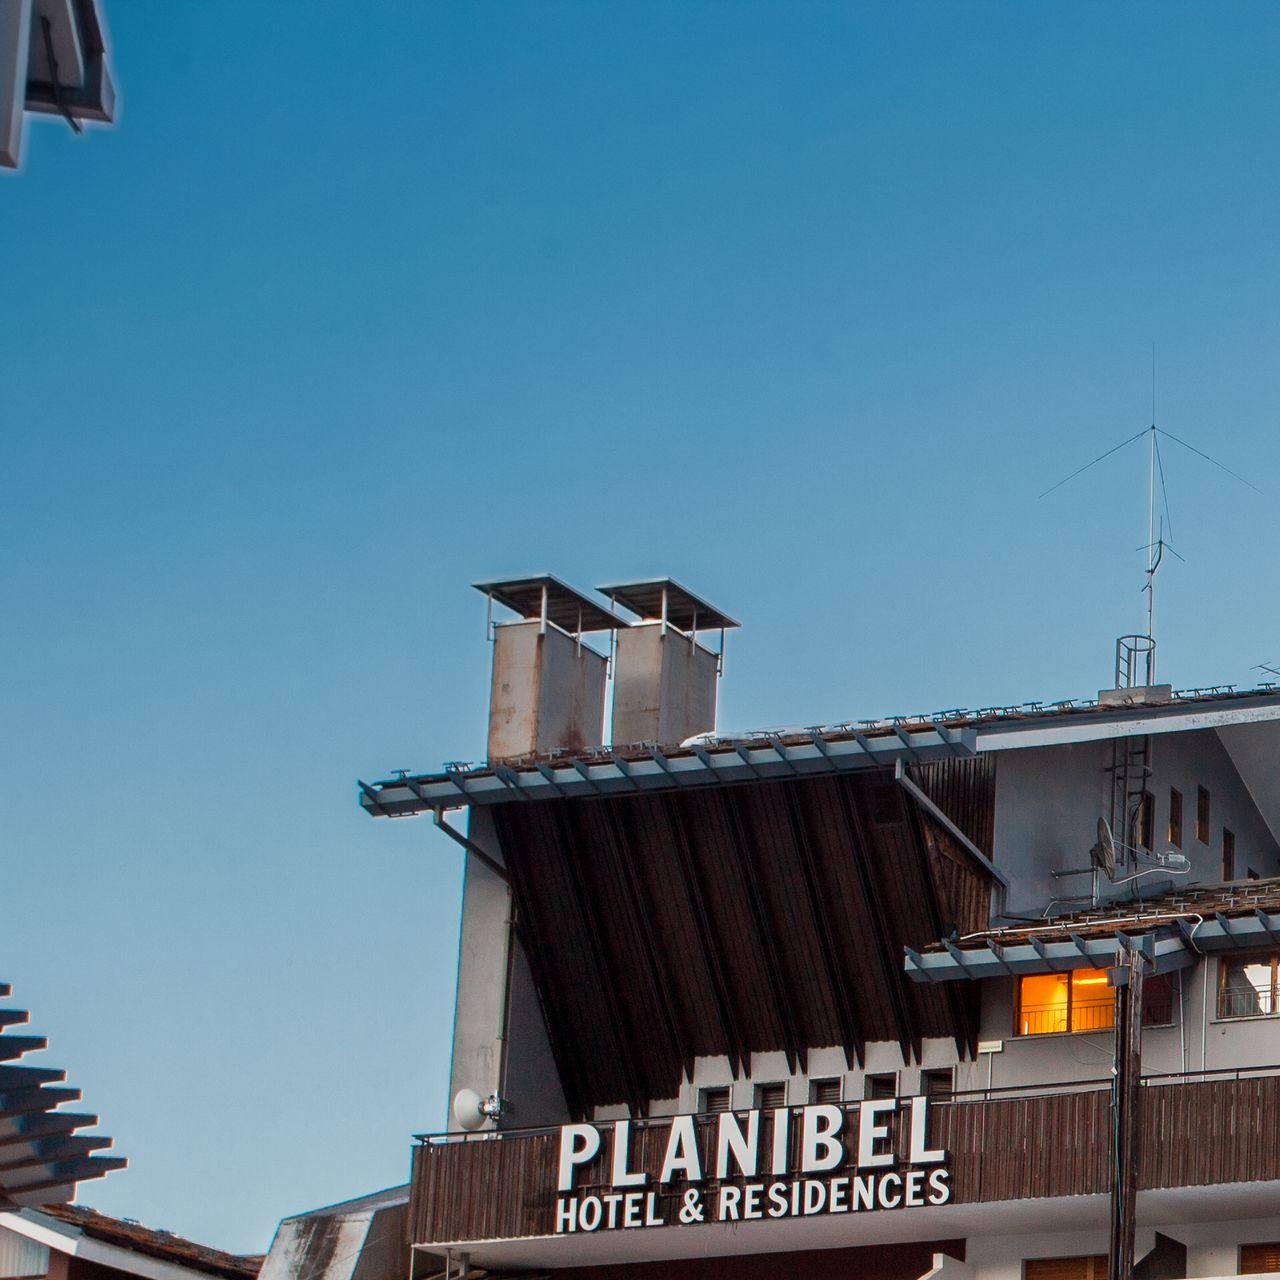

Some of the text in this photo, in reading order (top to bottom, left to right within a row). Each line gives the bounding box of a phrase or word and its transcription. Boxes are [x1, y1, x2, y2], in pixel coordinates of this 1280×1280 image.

[557, 1096, 946, 1192] PLANIBEL
[557, 1168, 951, 1233] HOTEL & RESIDENCES
